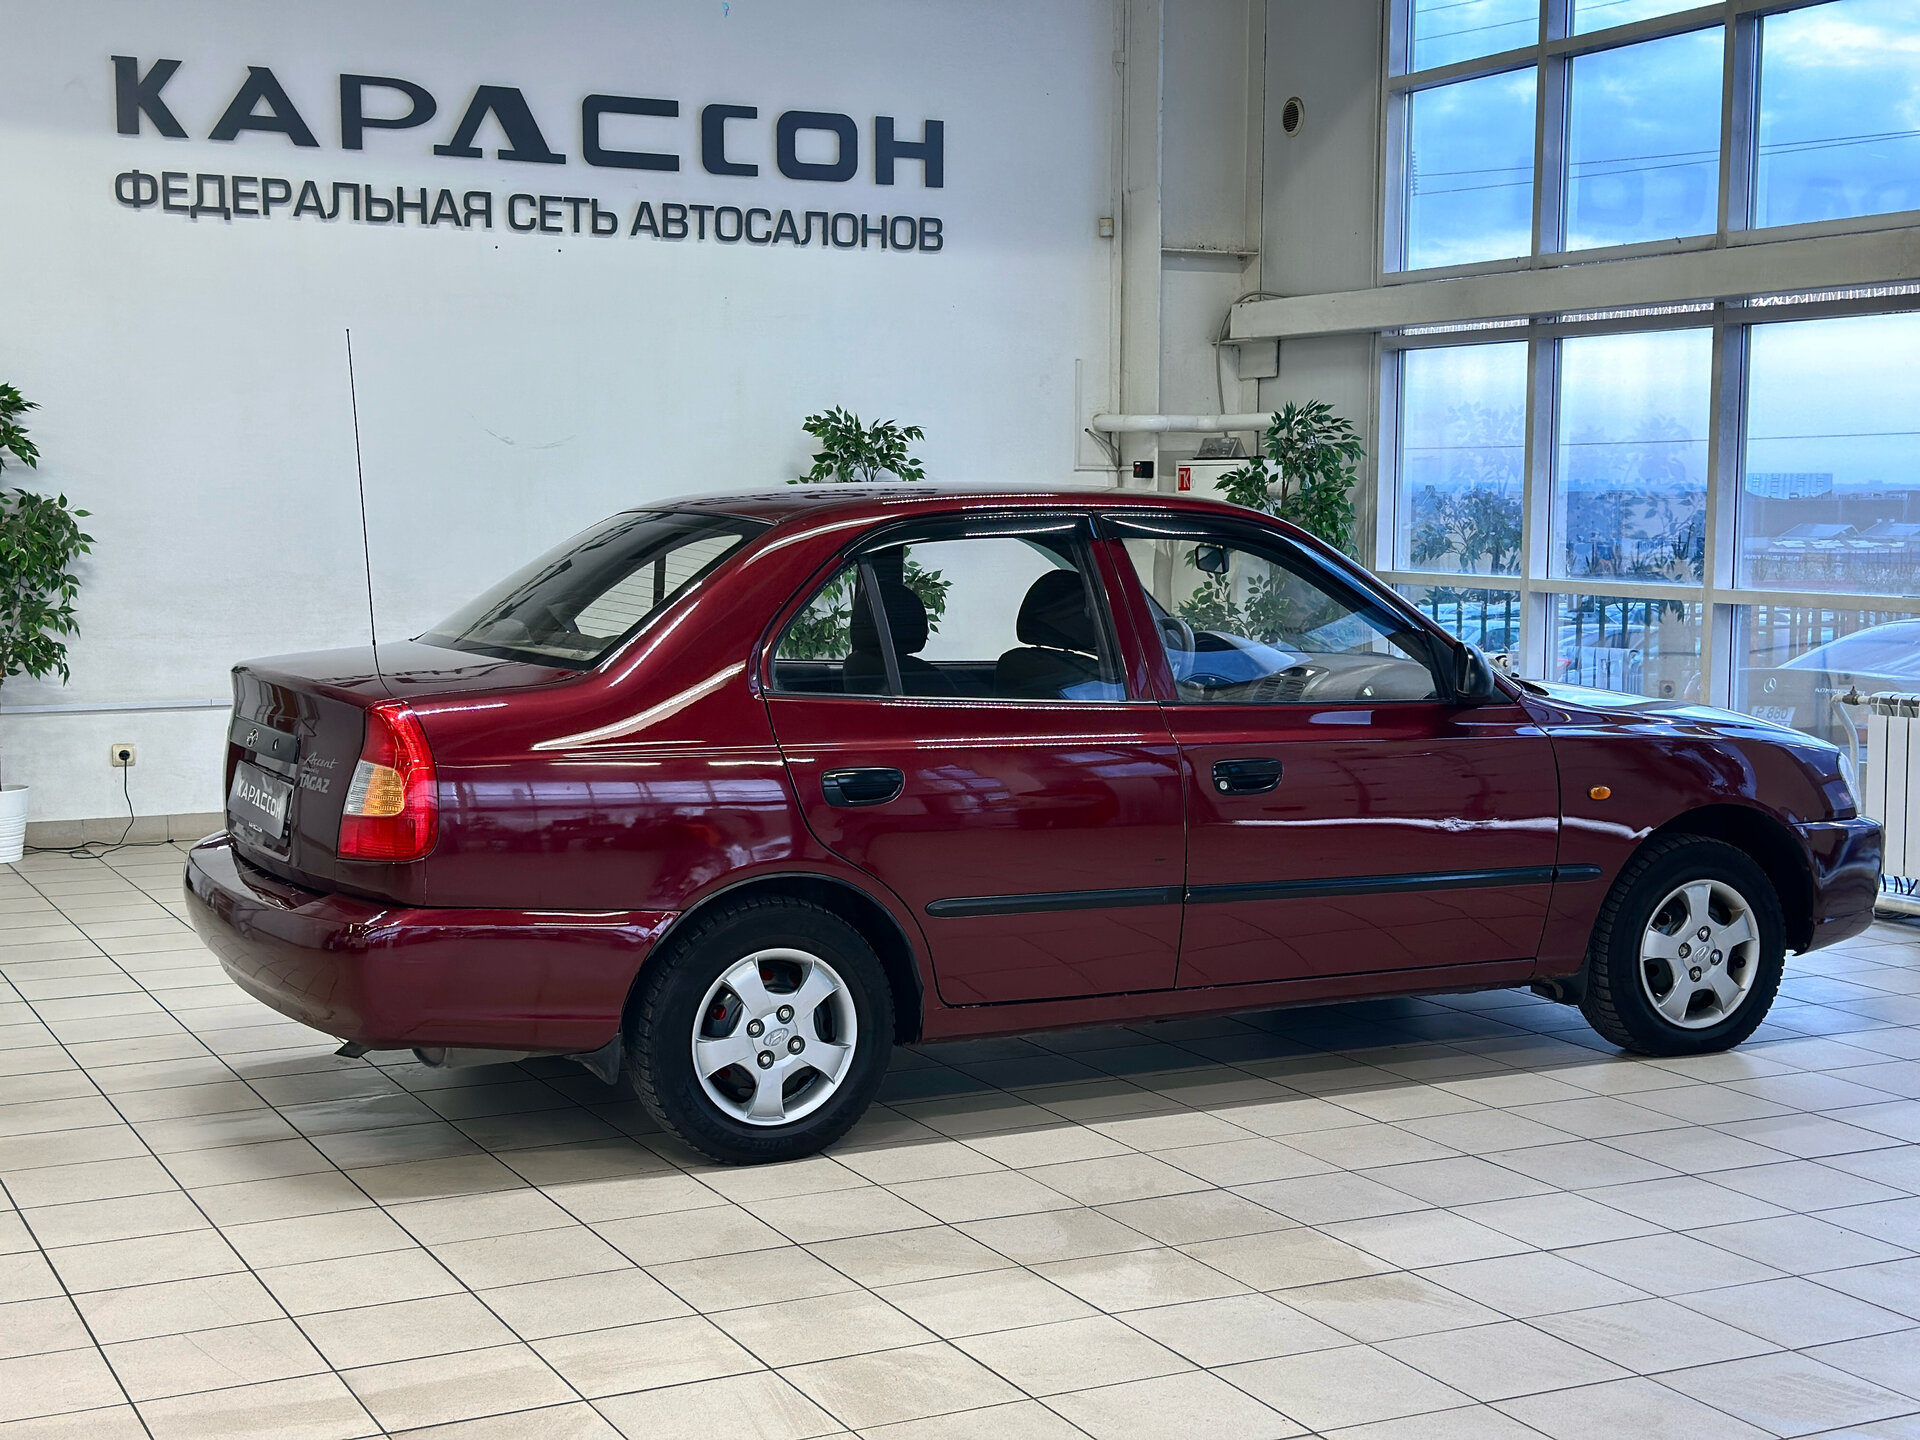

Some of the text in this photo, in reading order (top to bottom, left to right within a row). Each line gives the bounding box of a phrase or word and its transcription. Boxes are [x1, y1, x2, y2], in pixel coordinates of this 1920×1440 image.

[114, 169, 944, 252] ФЕДЕРАЛЬНАЯ СЕТЬ АВТОСАЛОНОВ
[302, 751, 340, 769] Accent
[299, 773, 331, 794] TAGAZ
